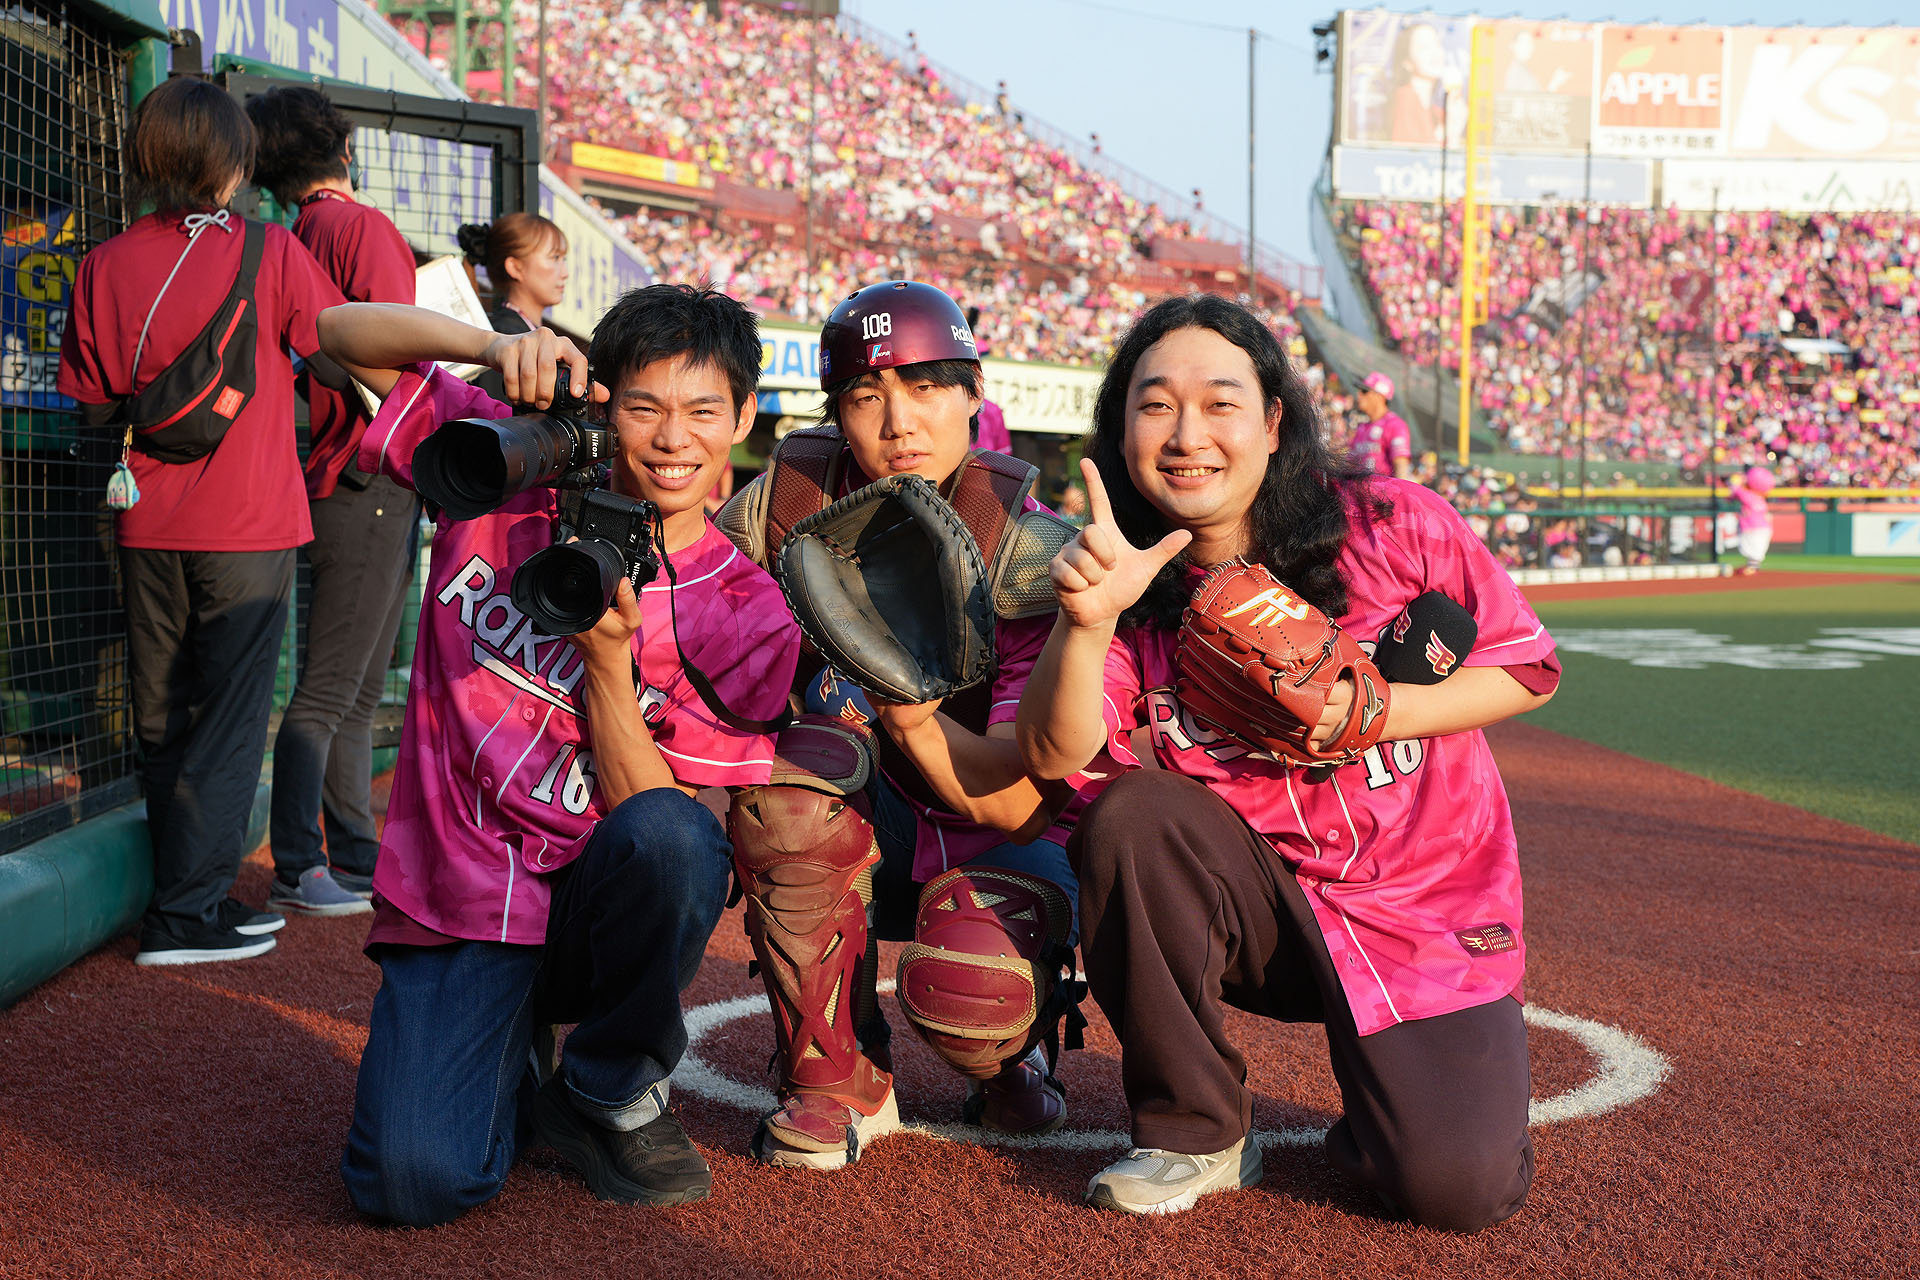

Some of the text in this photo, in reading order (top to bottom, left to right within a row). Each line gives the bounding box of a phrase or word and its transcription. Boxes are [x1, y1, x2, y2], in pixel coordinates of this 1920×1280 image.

[1602, 72, 1720, 106] APPLE
[861, 312, 892, 340] 108
[591, 432, 599, 458] Nikon
[630, 562, 641, 586] Nikon
[529, 743, 597, 816] 16
